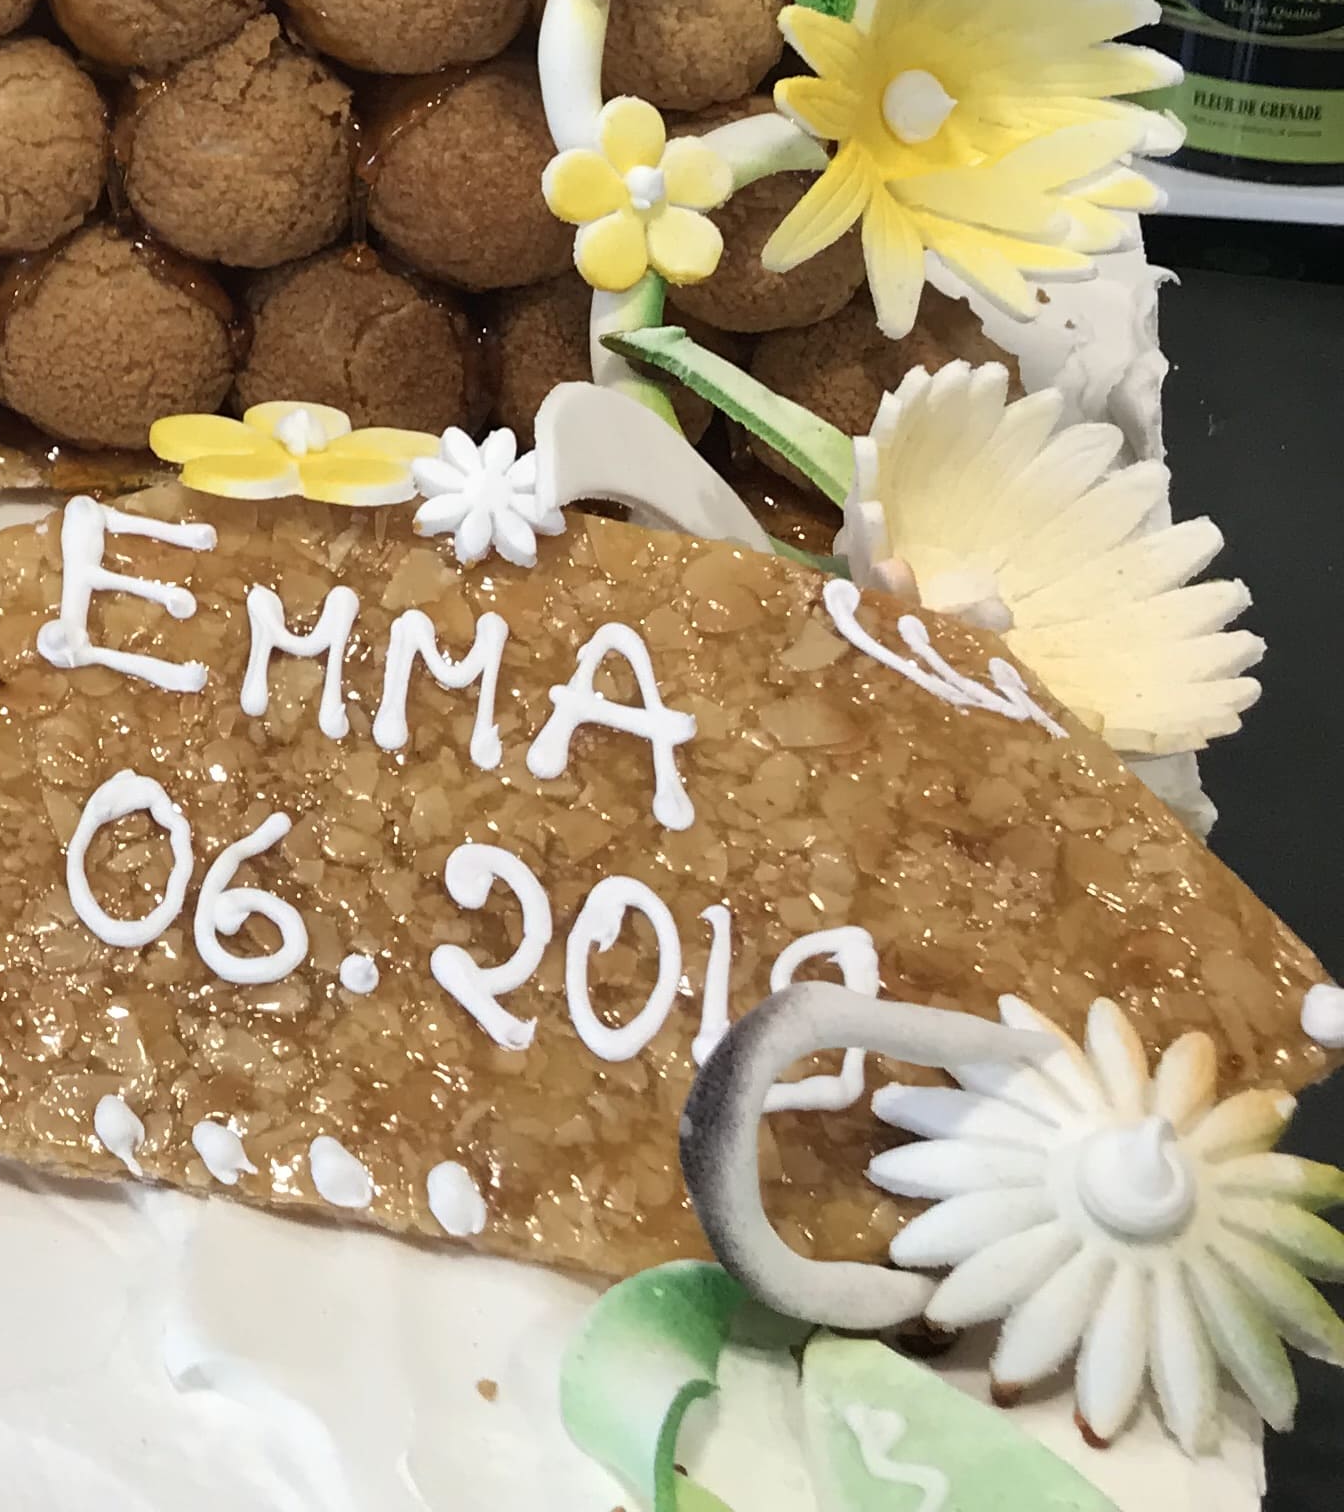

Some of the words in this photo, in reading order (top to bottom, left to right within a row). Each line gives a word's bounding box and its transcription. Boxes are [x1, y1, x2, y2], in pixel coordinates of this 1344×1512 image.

[1193, 89, 1235, 113] FLEUR
[1238, 98, 1258, 117] DE
[1260, 100, 1323, 122] GRENADE
[37, 494, 698, 831] EMMA
